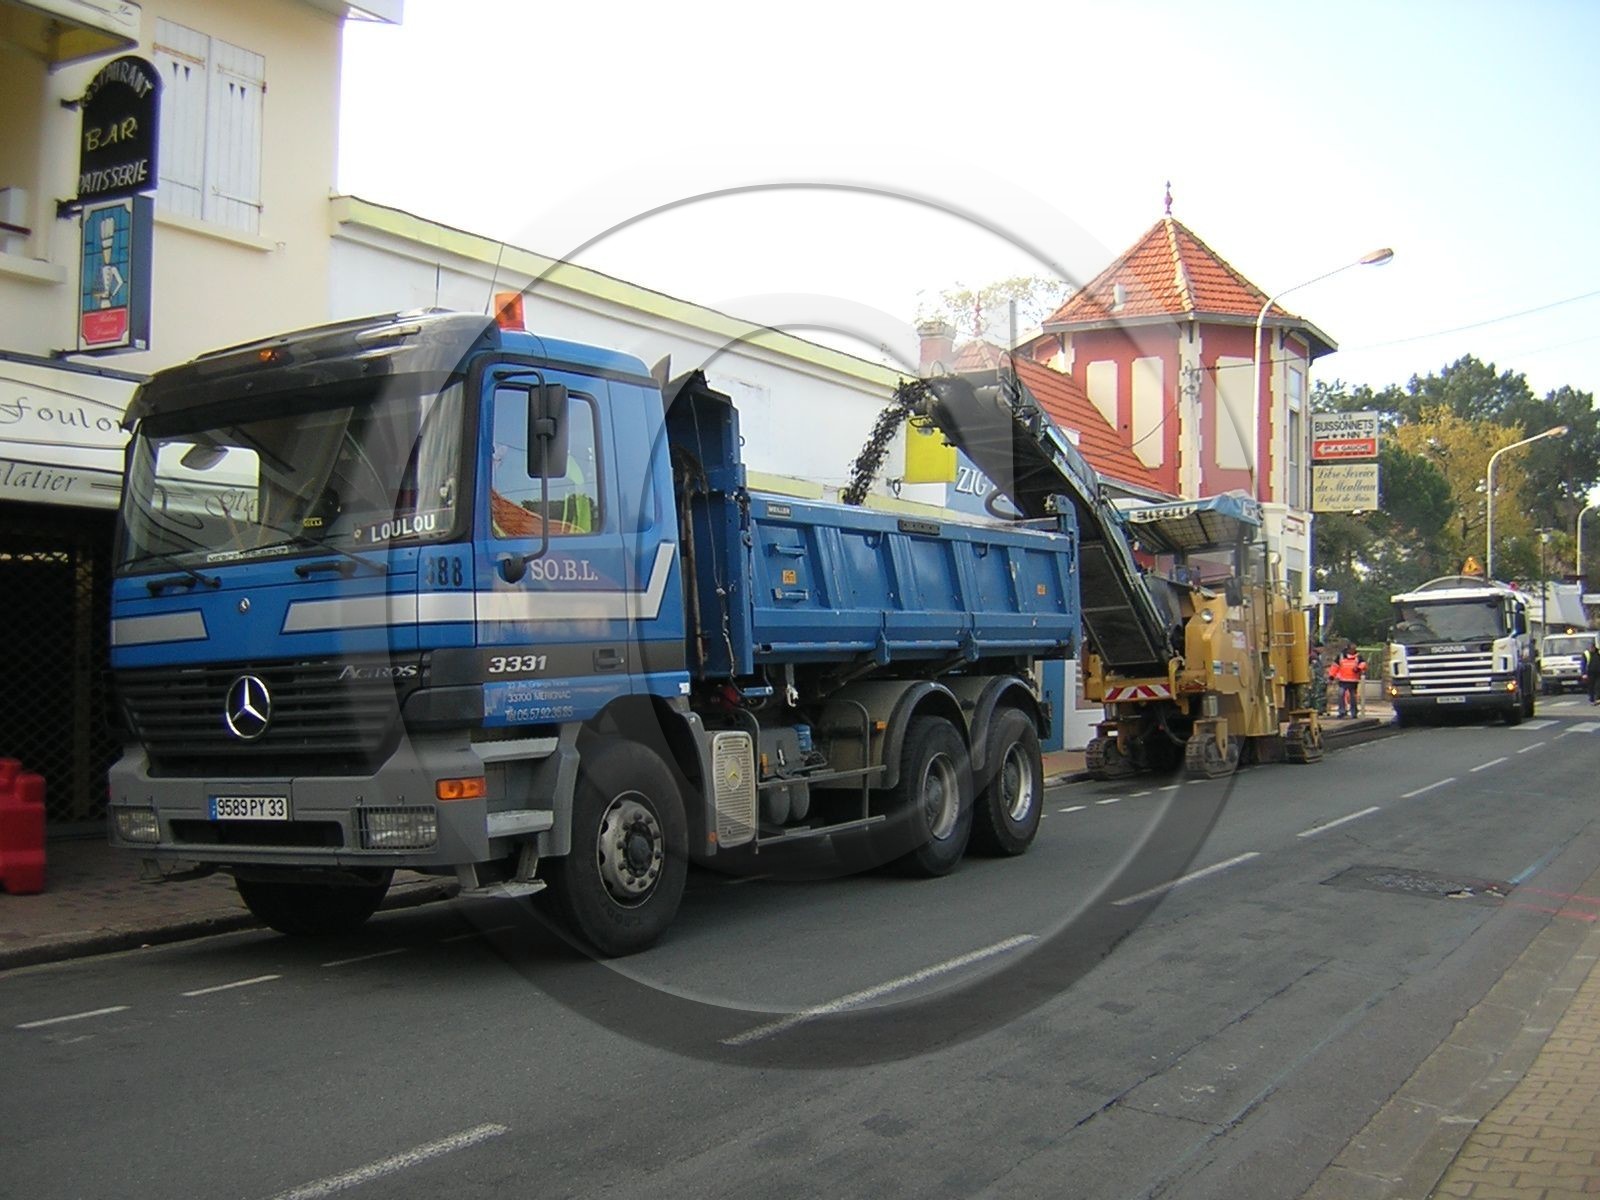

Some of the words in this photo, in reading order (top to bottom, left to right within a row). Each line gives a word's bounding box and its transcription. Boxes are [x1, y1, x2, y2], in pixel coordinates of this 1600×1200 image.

[85, 117, 138, 151] BAR
[79, 160, 148, 194] PATISSERIE
[1314, 419, 1374, 432] BUISSONNETS
[955, 466, 987, 496] ZIG
[371, 514, 436, 543] LOULOU
[530, 559, 599, 581] SO.B.L.
[1431, 645, 1466, 653] SCANIA
[488, 655, 547, 673] 3331
[217, 799, 248, 816] 9589
[250, 799, 265, 816] PY
[268, 799, 284, 816] 33
